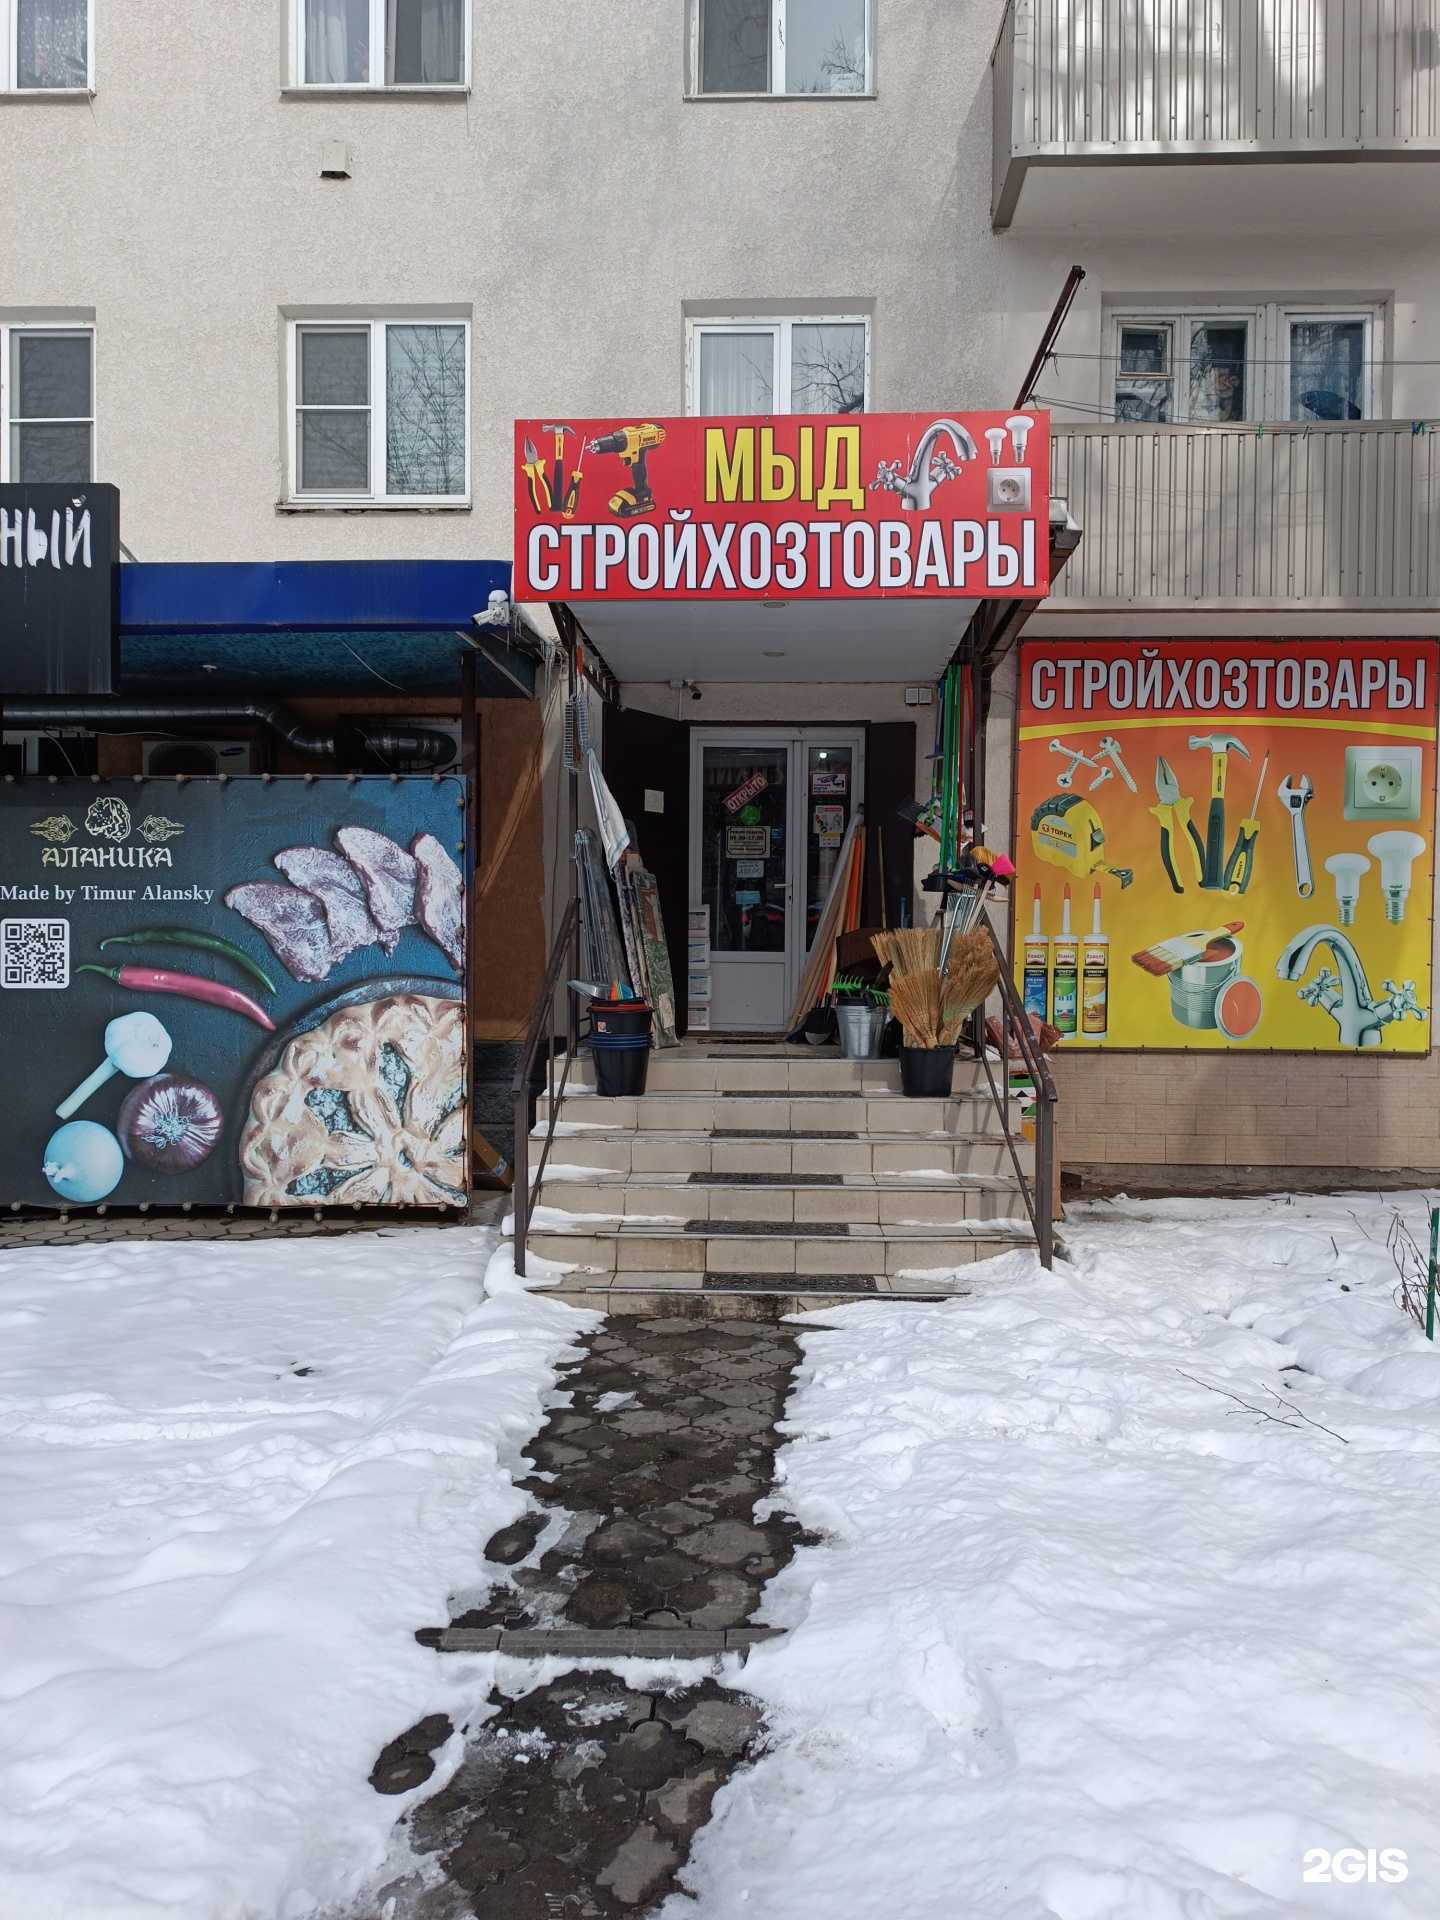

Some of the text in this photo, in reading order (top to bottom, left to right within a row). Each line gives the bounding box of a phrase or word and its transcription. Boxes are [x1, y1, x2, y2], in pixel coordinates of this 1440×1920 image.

[704, 425, 866, 511] МЫД
[527, 508, 1036, 591] СТРОЙХОЗТОВАРЫ
[1031, 648, 1426, 711] СТРОЙХОЗТОВАРЫ
[726, 775, 766, 810] ОТКРЫТО
[41, 846, 173, 869] АЛАНИКА
[0, 885, 216, 904] Made by Timur Alansky
